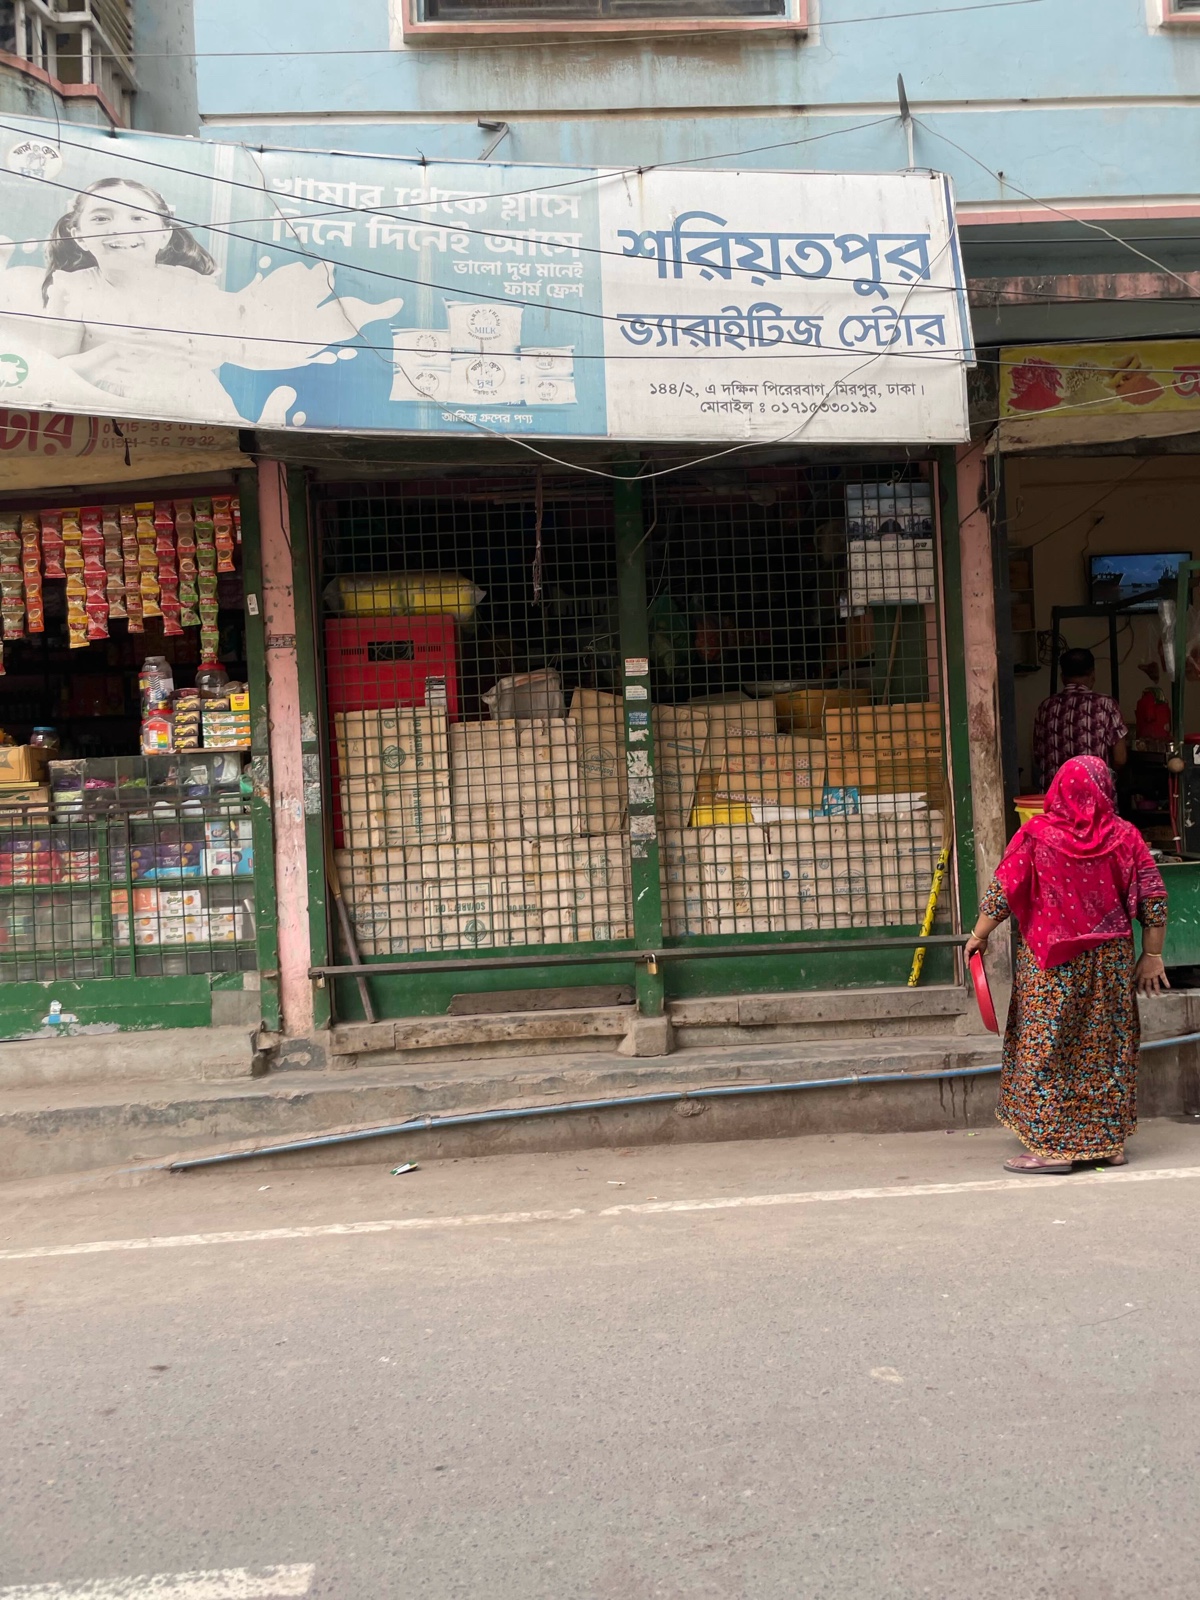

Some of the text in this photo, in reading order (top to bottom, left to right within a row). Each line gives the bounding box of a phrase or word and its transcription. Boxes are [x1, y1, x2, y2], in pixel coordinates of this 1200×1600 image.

[272, 177, 582, 222] খামার থেকে গ্লাসে
[270, 207, 583, 258] দিনে দিনেই আসে
[453, 260, 584, 280] ভালো দুধ মানেই
[503, 281, 584, 298] ফার্ম ফ্রেশ
[617, 302, 947, 351] ভ্যারাইটিজ স্টোর
[650, 382, 699, 397] ১৪৪/২,
[705, 383, 716, 395] এ
[833, 381, 882, 399] মিরপুর,
[700, 398, 754, 413] মোবাইল
[514, 414, 533, 424] পণ্য
